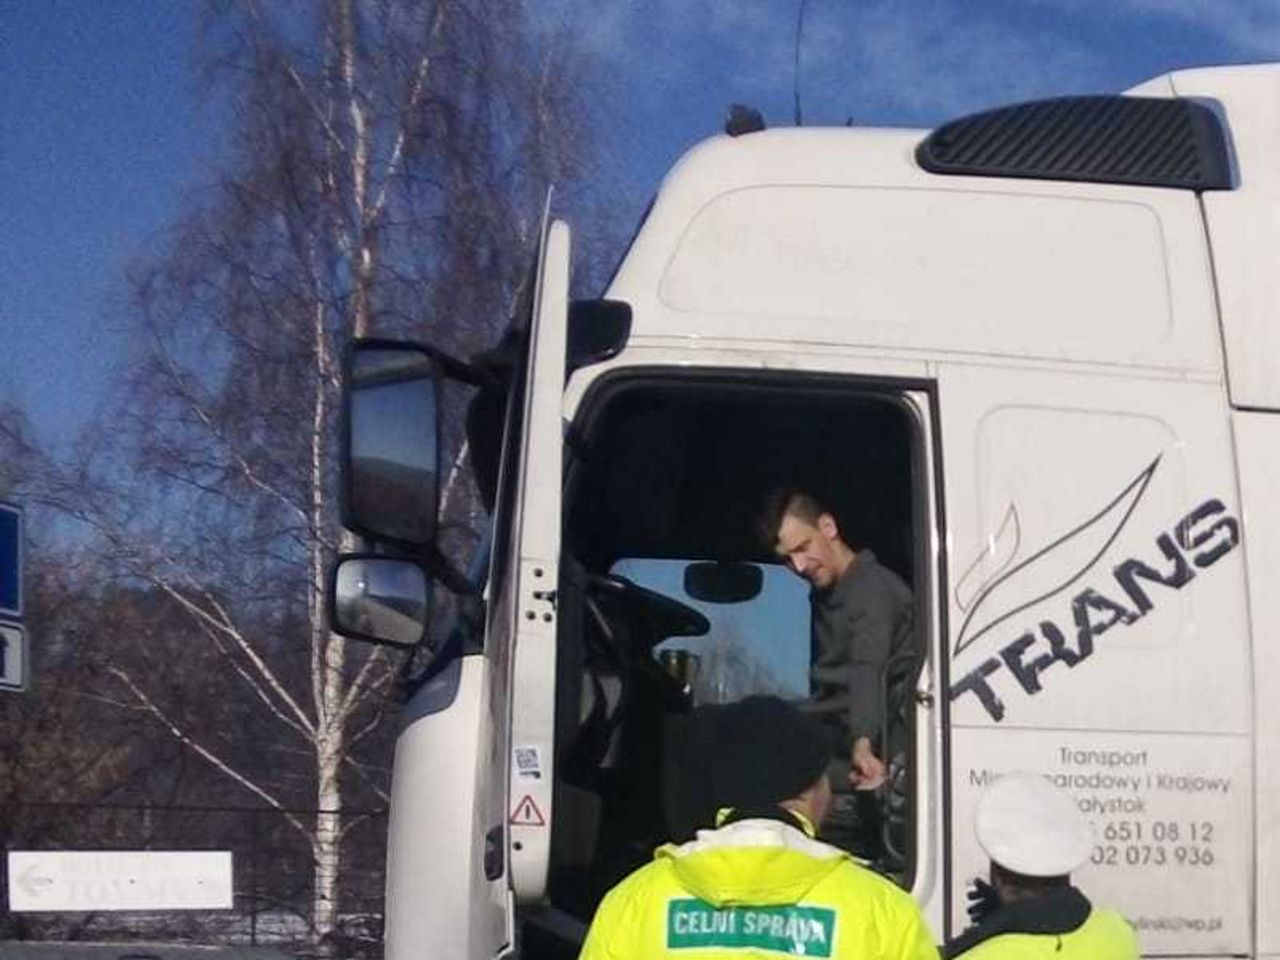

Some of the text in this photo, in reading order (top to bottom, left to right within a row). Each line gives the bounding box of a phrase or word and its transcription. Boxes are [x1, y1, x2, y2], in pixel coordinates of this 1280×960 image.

[950, 499, 1240, 723] TRANS
[1060, 747, 1148, 767] Transport
[1157, 775, 1231, 793] Krajowy
[1104, 821, 1142, 841] 651
[1152, 821, 1179, 842] 08
[1190, 822, 1214, 842] 12
[1089, 845, 1215, 866] 02 073 936
